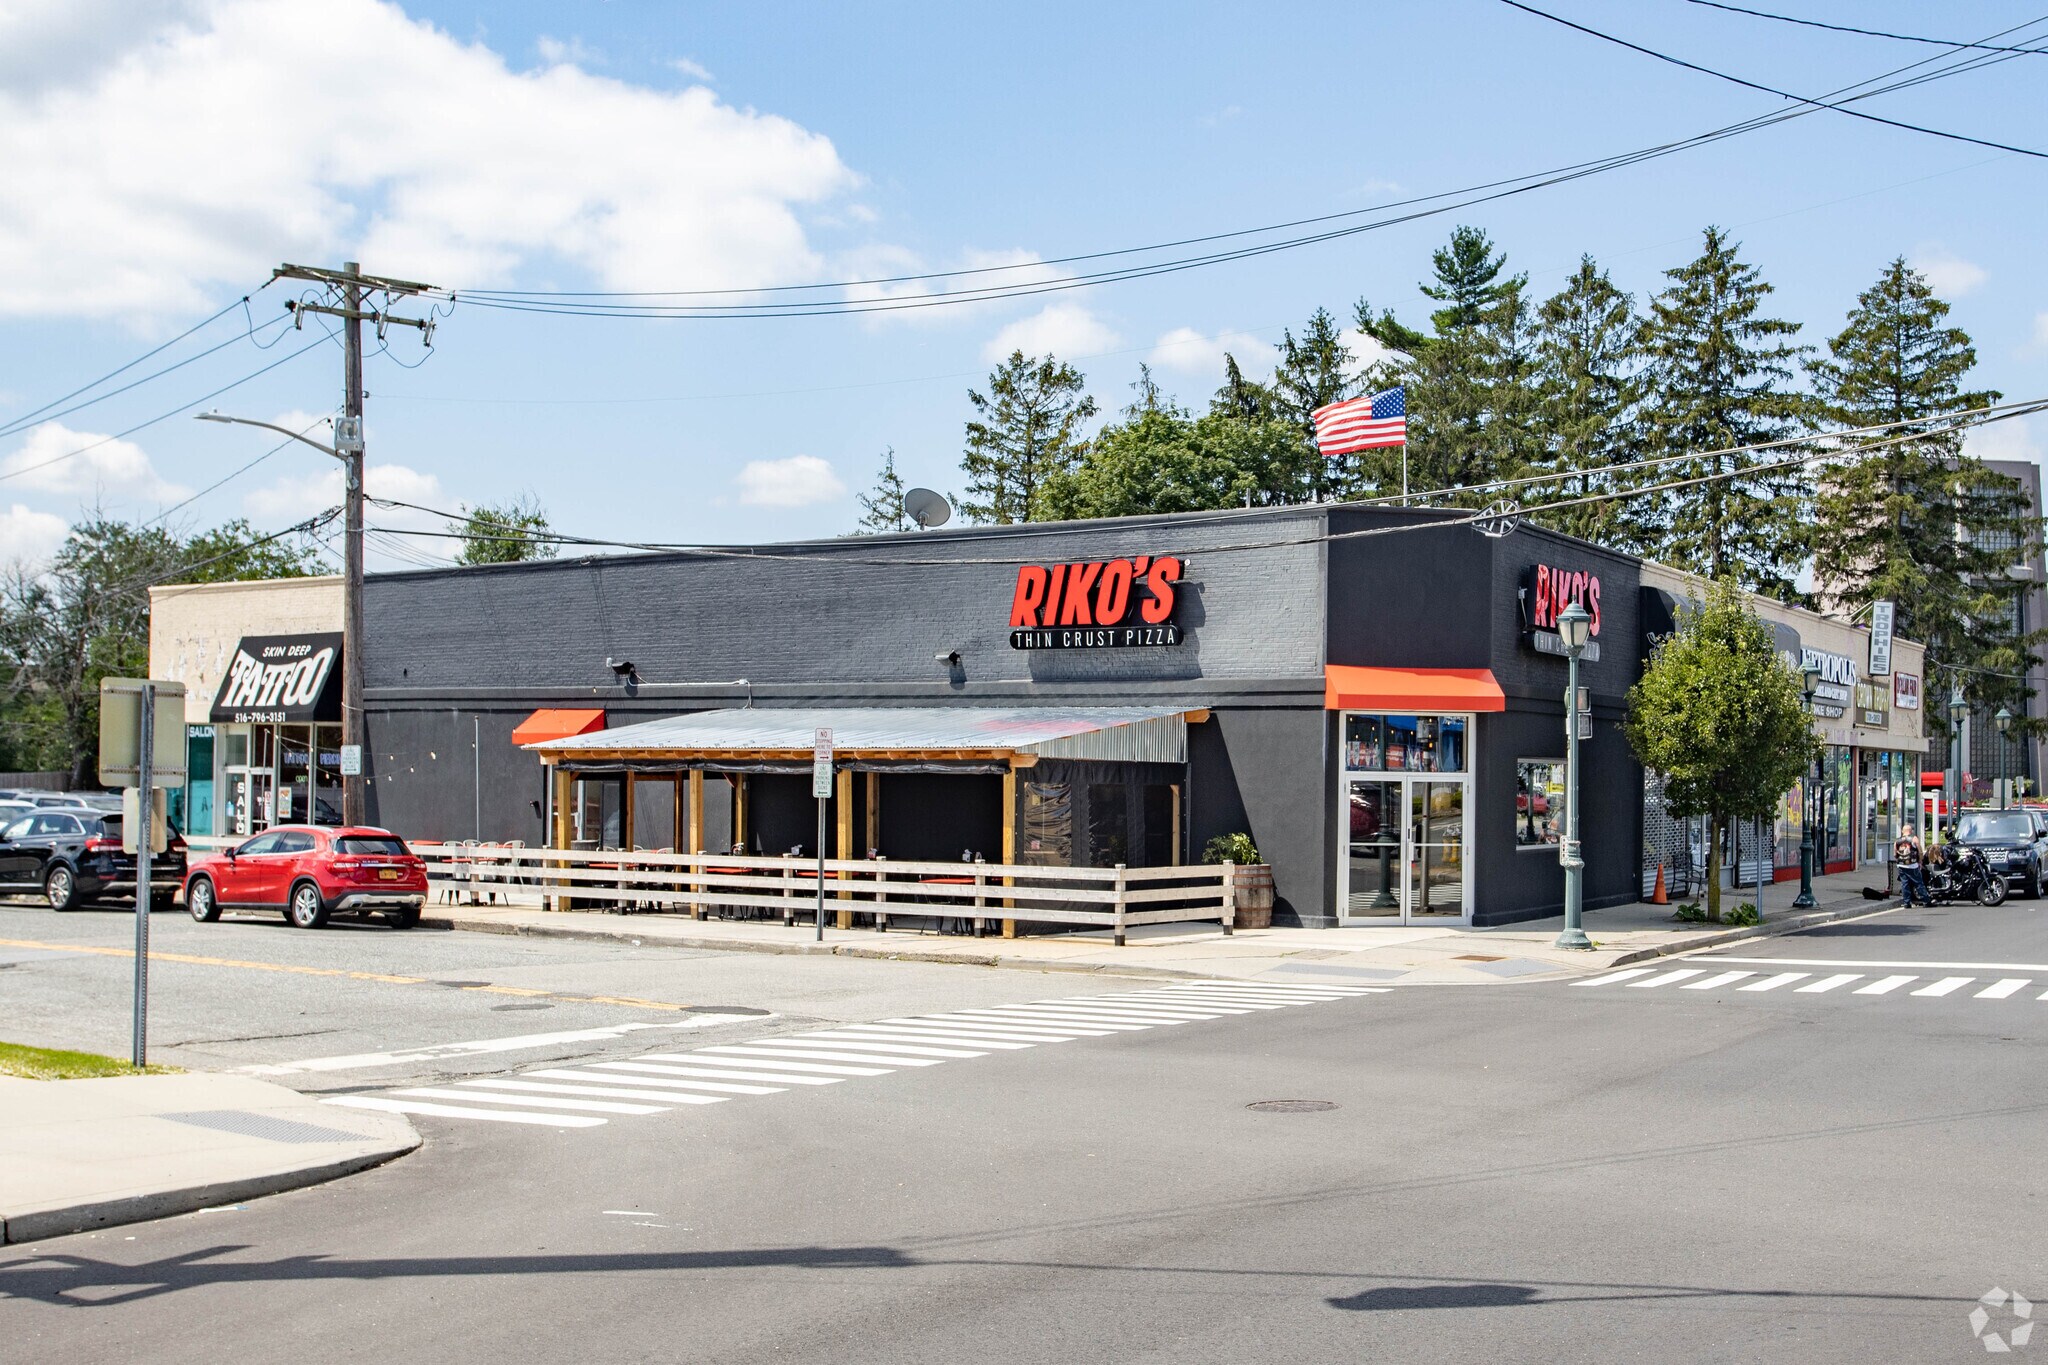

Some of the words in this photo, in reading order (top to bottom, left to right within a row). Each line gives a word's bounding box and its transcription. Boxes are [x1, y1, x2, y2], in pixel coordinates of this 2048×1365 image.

[1009, 556, 1181, 627] RIKO'S
[1016, 632, 1052, 648] THIN
[1063, 631, 1114, 647] CRUST
[1126, 629, 1175, 645] PIZZA
[1873, 605, 1890, 672] TROPHIES
[262, 646, 287, 657] SKIN
[287, 644, 312, 657] DEEP
[220, 647, 334, 707] TATTOO
[235, 712, 286, 723] 516-796-3151
[1825, 706, 1843, 717] SHOP
[189, 726, 215, 738] SALON
